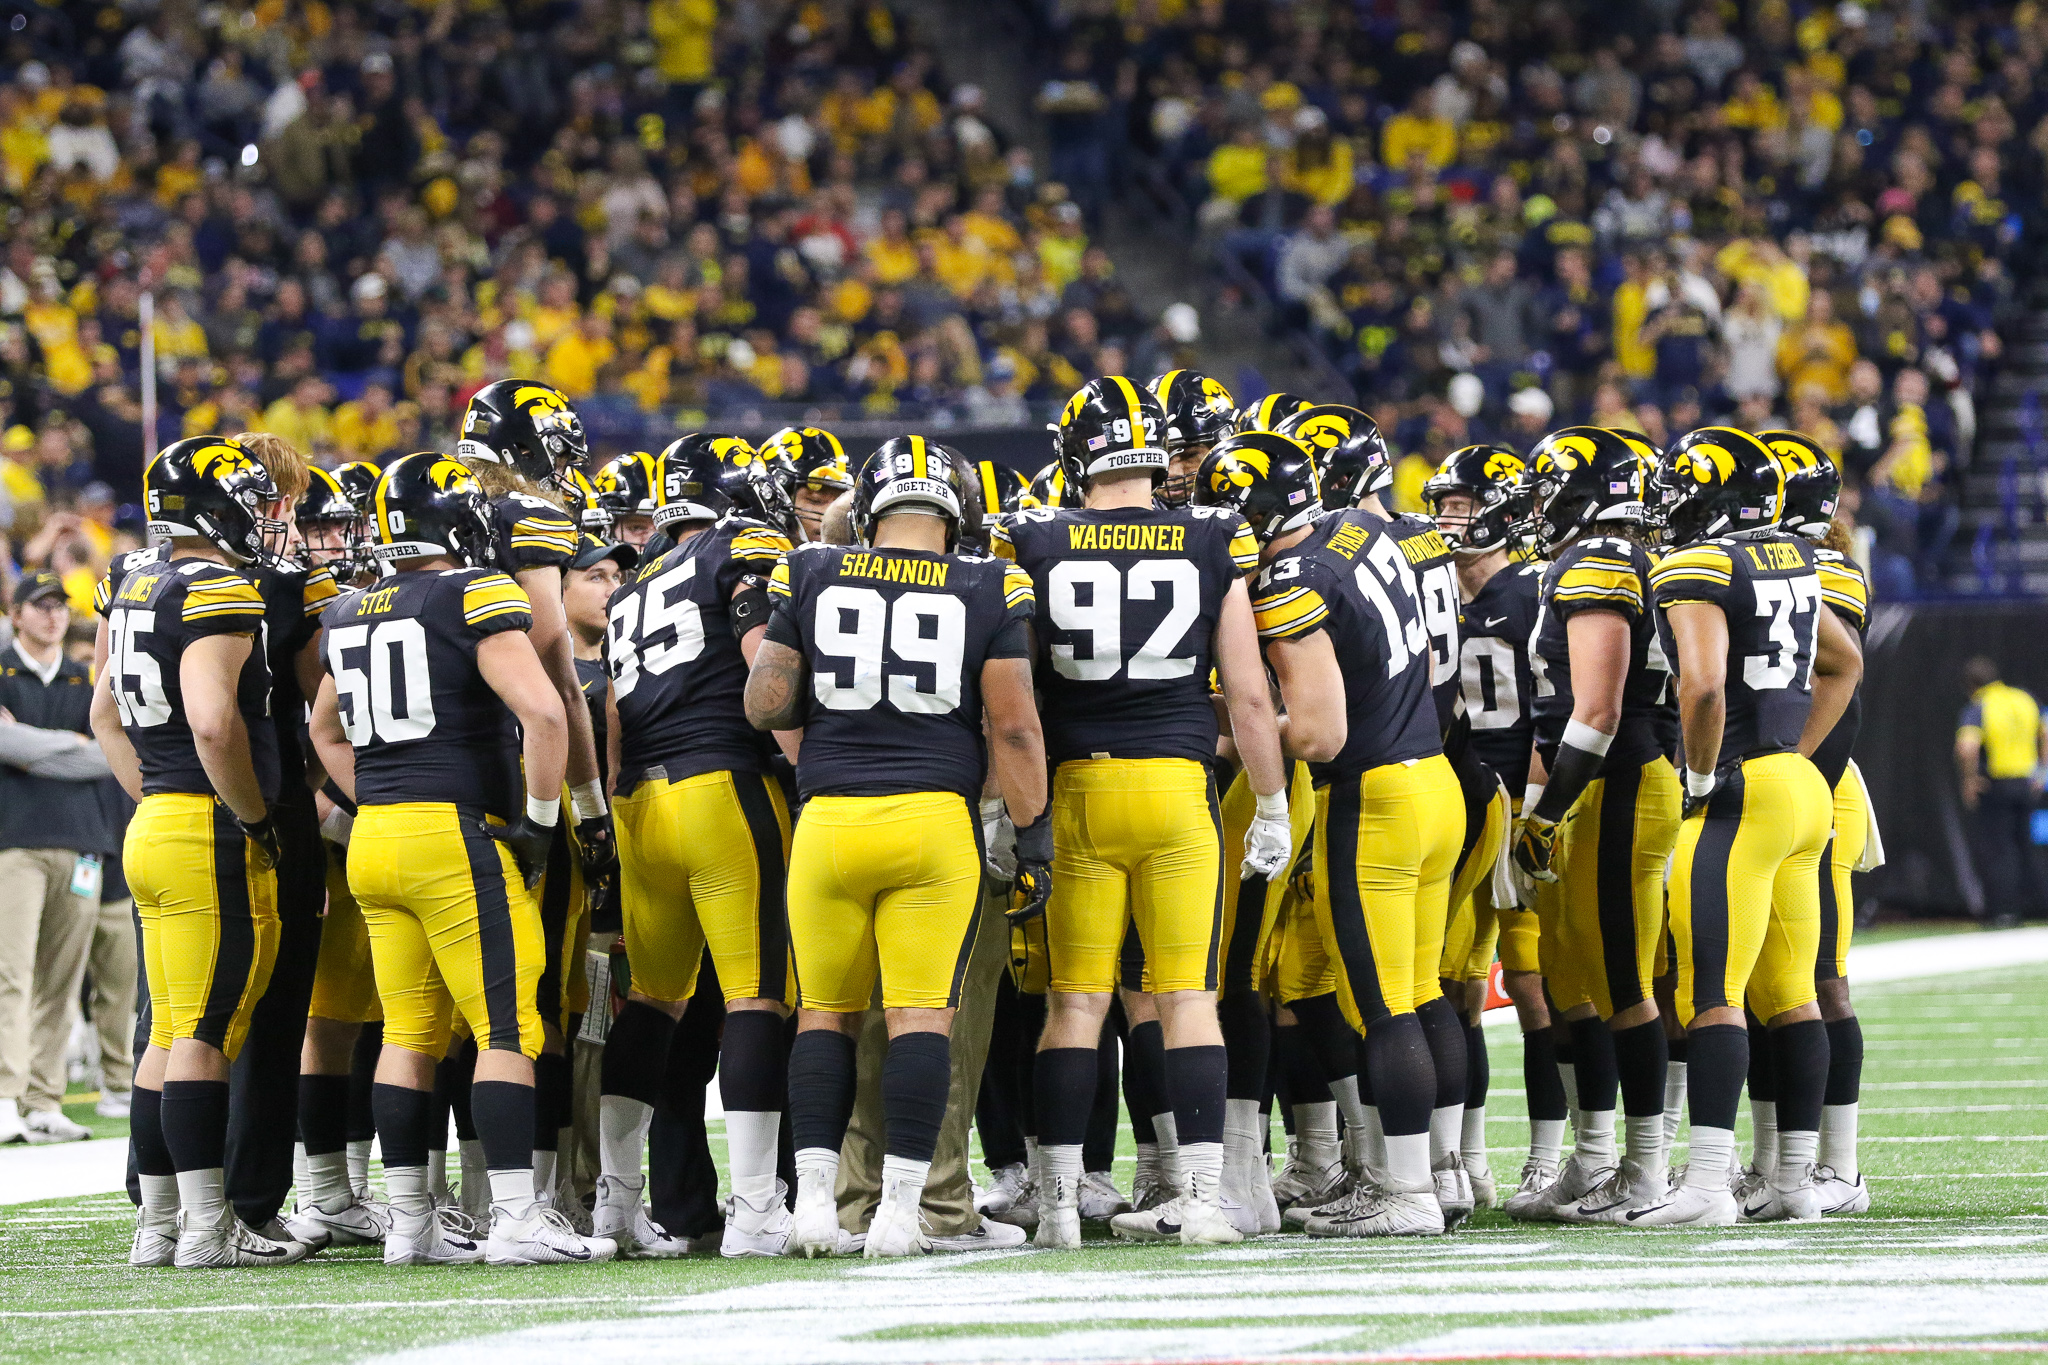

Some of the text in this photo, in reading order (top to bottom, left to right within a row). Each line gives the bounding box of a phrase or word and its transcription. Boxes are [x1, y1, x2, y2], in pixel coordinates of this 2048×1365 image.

[464, 410, 478, 433] 8
[1108, 452, 1163, 467] TOGETHER
[148, 489, 161, 513] 5
[665, 474, 680, 498] 5
[1069, 524, 1186, 552] WAGGONER
[1326, 521, 1370, 561] EVANS
[839, 553, 949, 588] SHANNON
[1258, 556, 1302, 591] 13
[1763, 542, 1806, 571] FISHER
[356, 586, 400, 616] STEC
[1353, 531, 1428, 680] 13
[606, 555, 706, 704] 85
[1048, 558, 1201, 681] 92
[1742, 574, 1822, 691] 37
[813, 585, 967, 715] 99
[327, 617, 437, 747] 50
